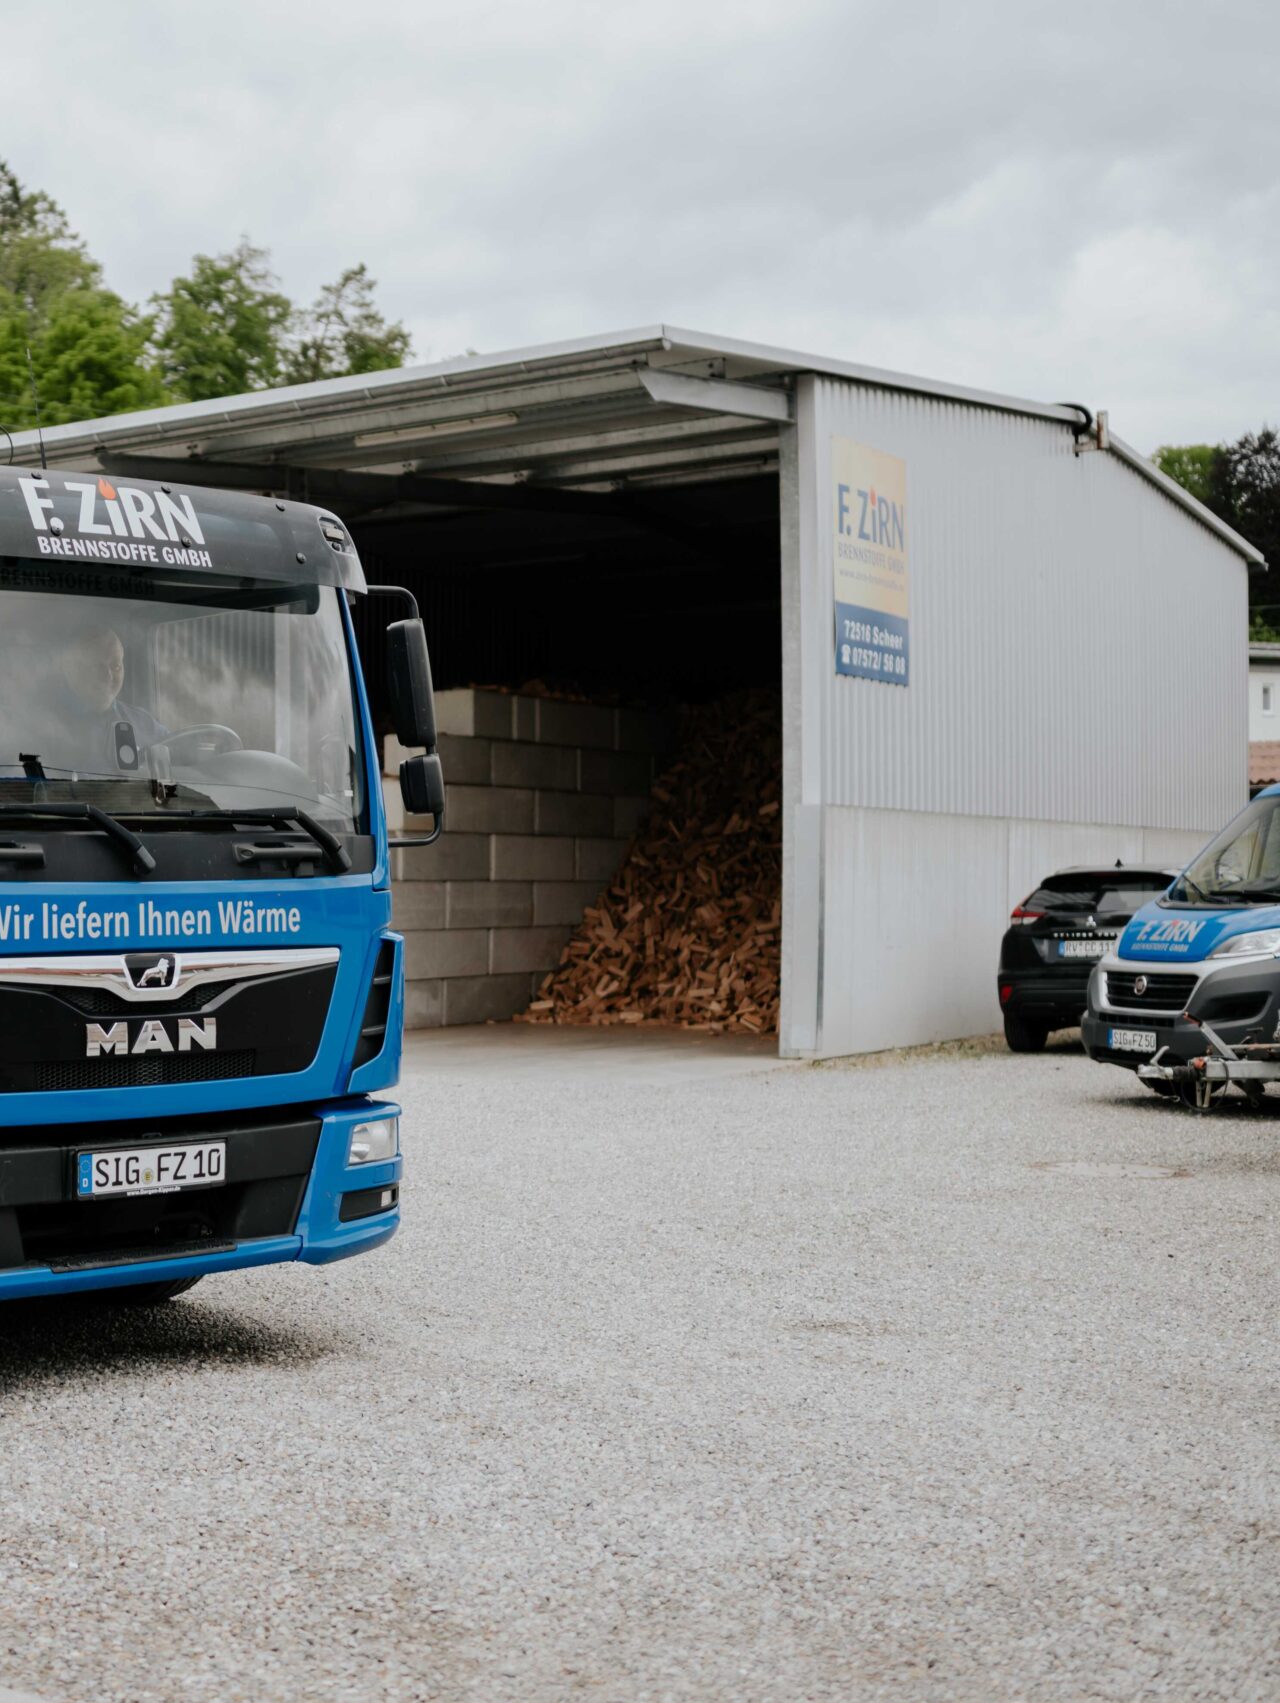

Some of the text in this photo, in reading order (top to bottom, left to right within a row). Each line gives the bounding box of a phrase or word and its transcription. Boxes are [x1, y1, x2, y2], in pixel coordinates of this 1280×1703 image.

[18, 478, 64, 536] F.
[837, 483, 851, 536] F.
[37, 536, 213, 568] BRENNSTOFFE GMBH
[843, 619, 903, 650] 72516 Scheer
[883, 653, 894, 672] 56
[895, 656, 906, 675] 08
[42, 901, 130, 940] liefern
[139, 901, 211, 937] Ihnen
[218, 900, 301, 934] Wärme
[86, 1017, 217, 1057] MAN
[1113, 1031, 1128, 1046] SIG
[95, 1156, 140, 1188] SIG
